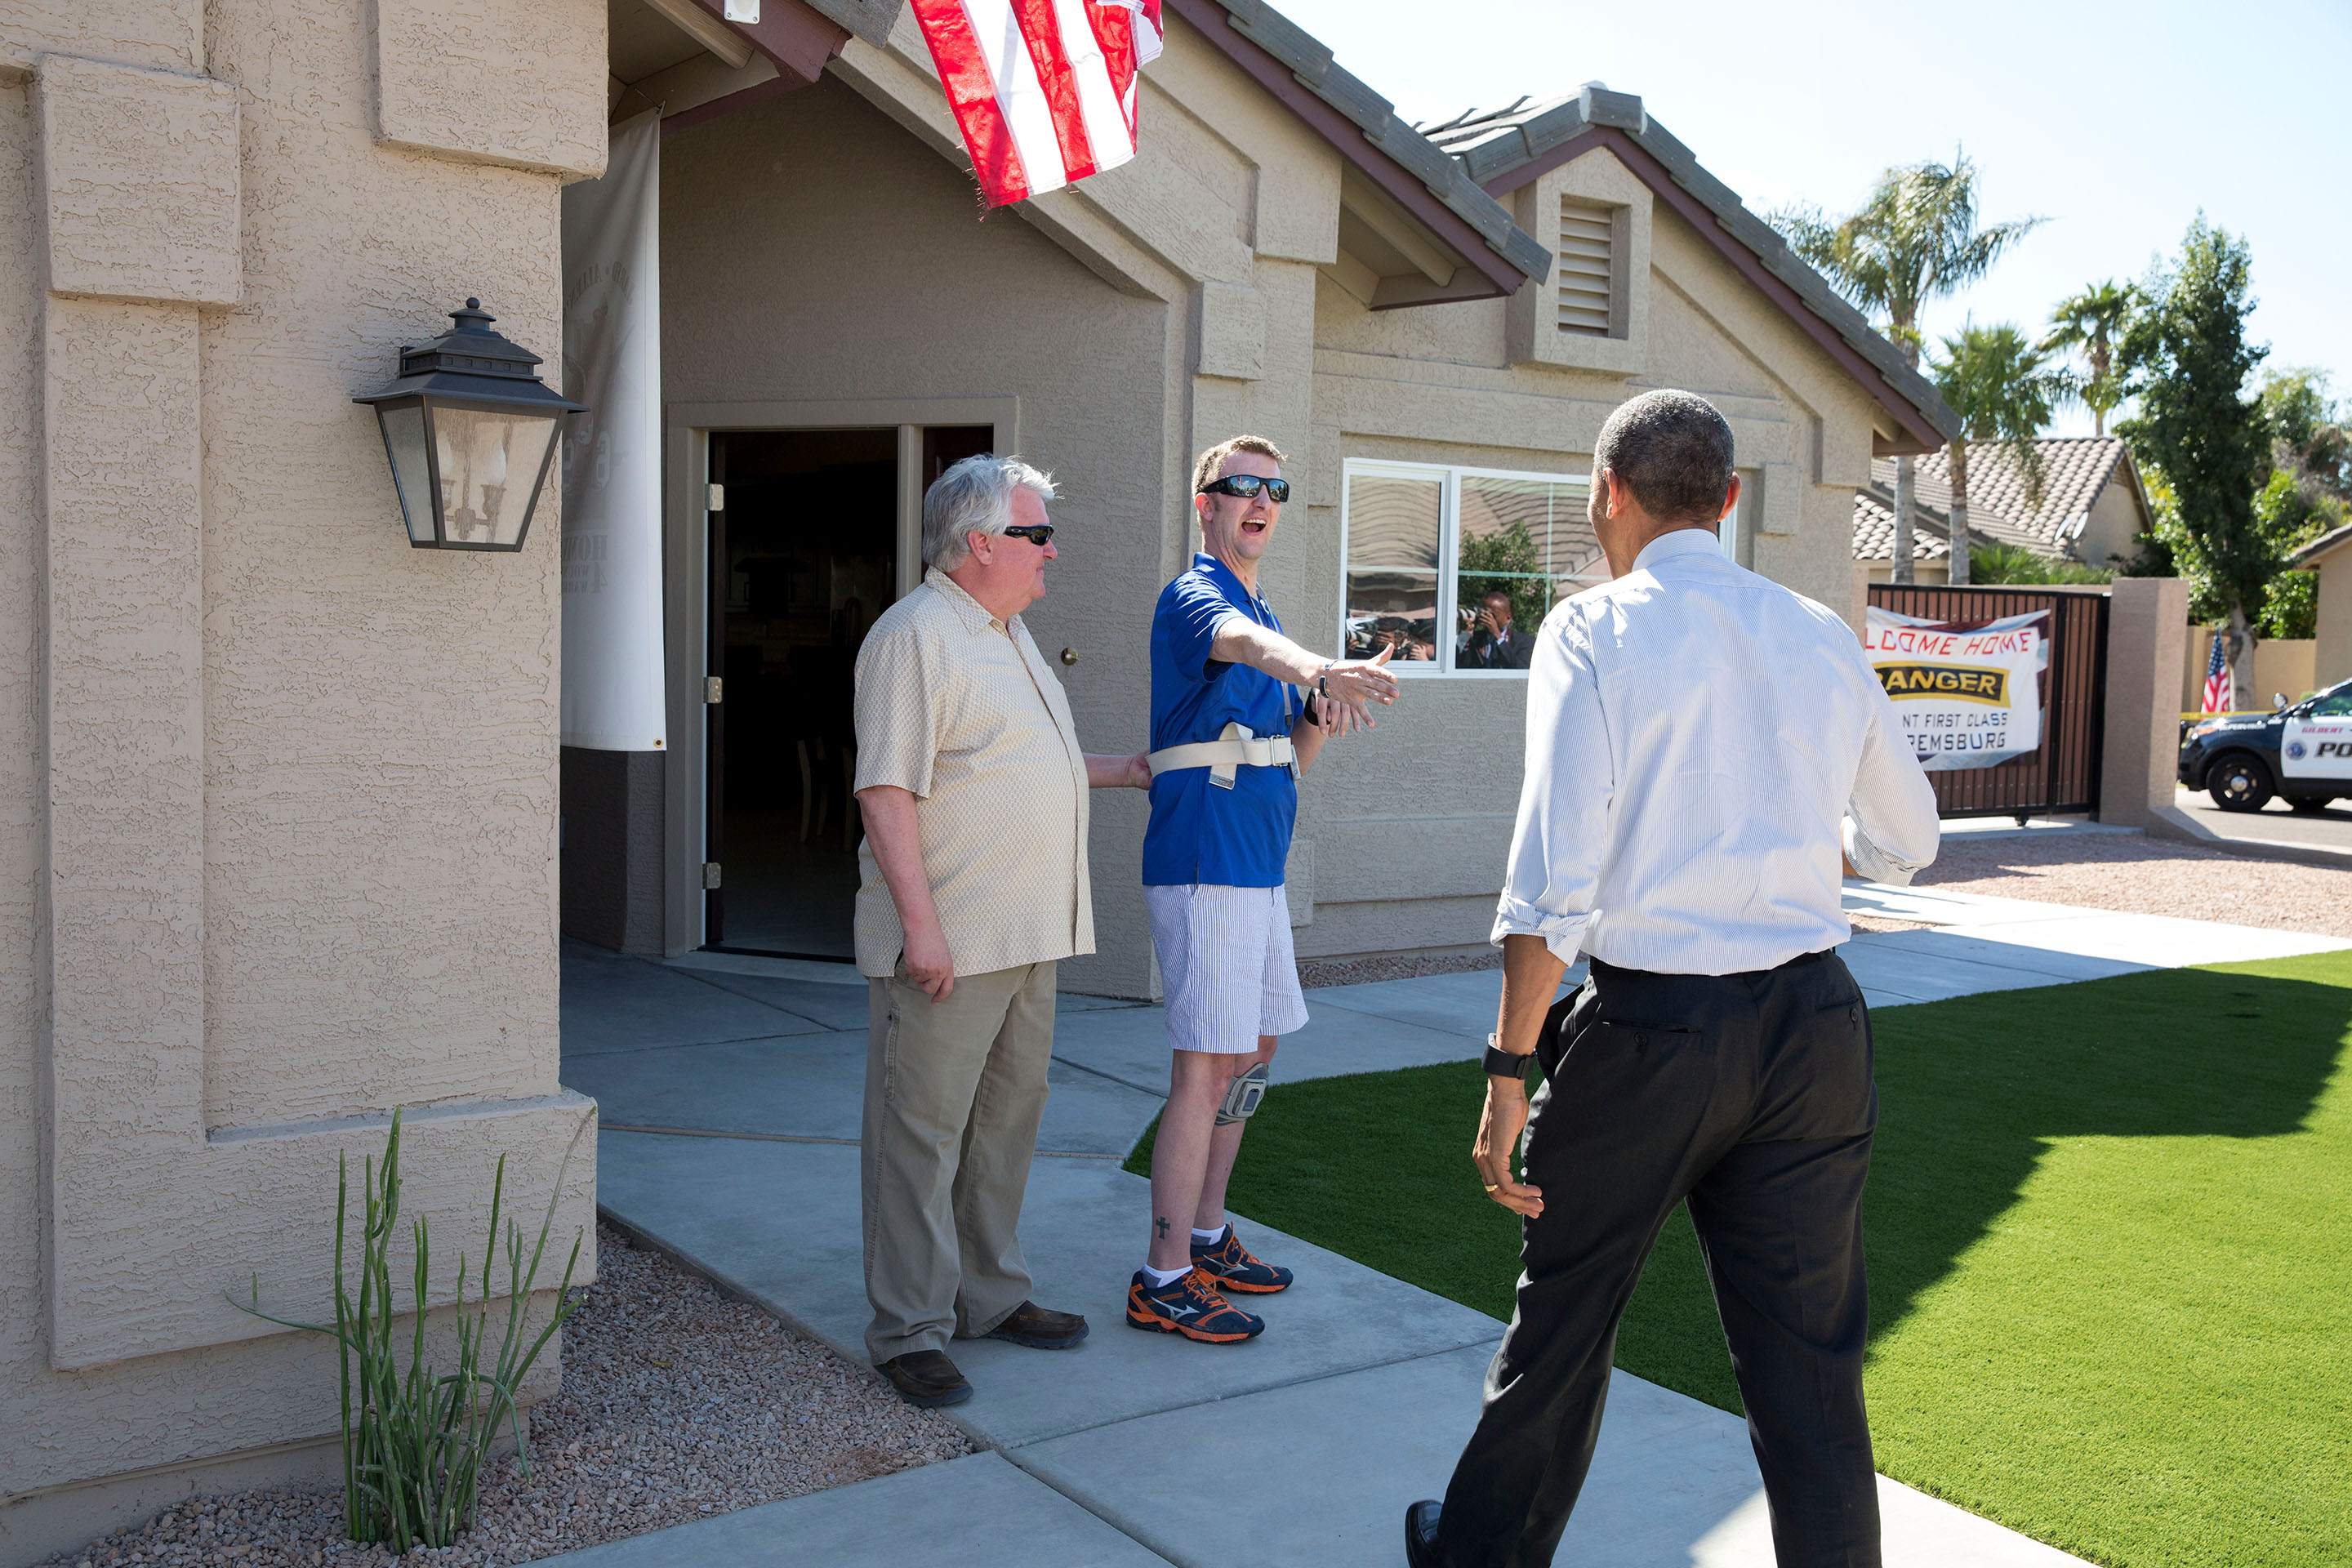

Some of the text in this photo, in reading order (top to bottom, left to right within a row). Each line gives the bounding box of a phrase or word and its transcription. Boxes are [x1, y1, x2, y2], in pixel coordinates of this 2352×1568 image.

[1964, 631, 2032, 655] HOME
[1879, 670, 1996, 695] ANGER
[1925, 714, 1962, 728] FIRST
[1967, 712, 2008, 728] CLASS
